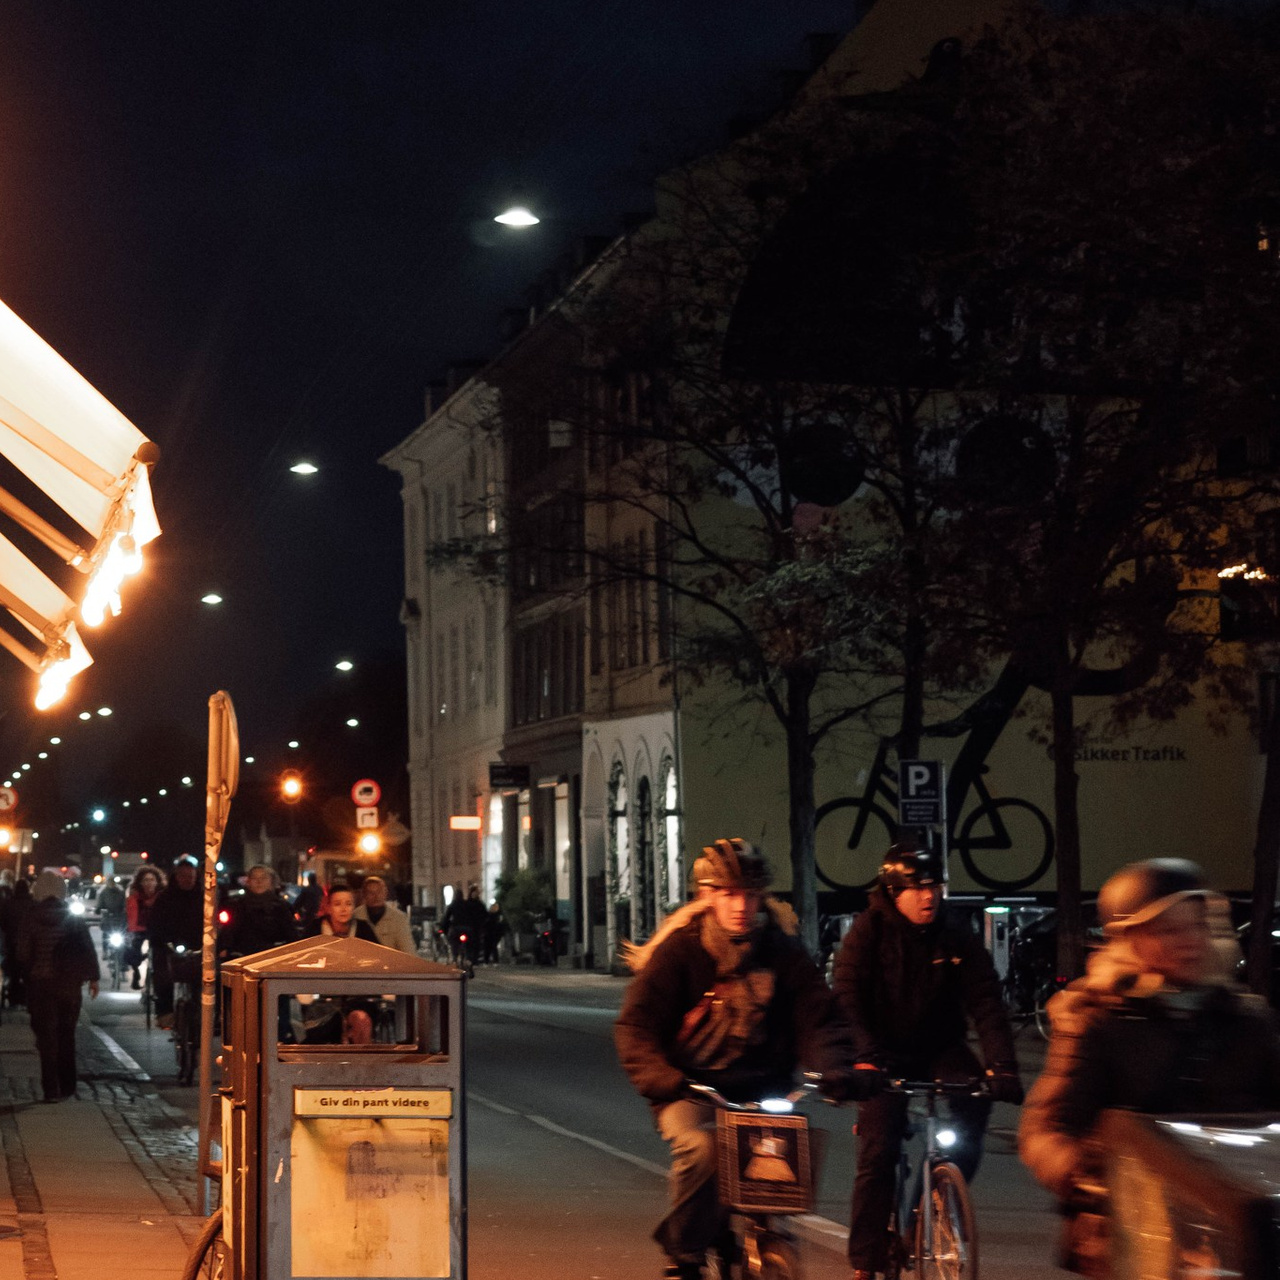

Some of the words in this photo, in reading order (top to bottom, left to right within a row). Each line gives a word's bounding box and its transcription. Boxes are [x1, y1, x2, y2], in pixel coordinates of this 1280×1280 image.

[1132, 745, 1186, 762] Trafik
[907, 765, 931, 796] P
[320, 1097, 339, 1108] Giv
[342, 1097, 360, 1108] din
[363, 1098, 388, 1110] pant
[391, 1097, 430, 1108] videre
